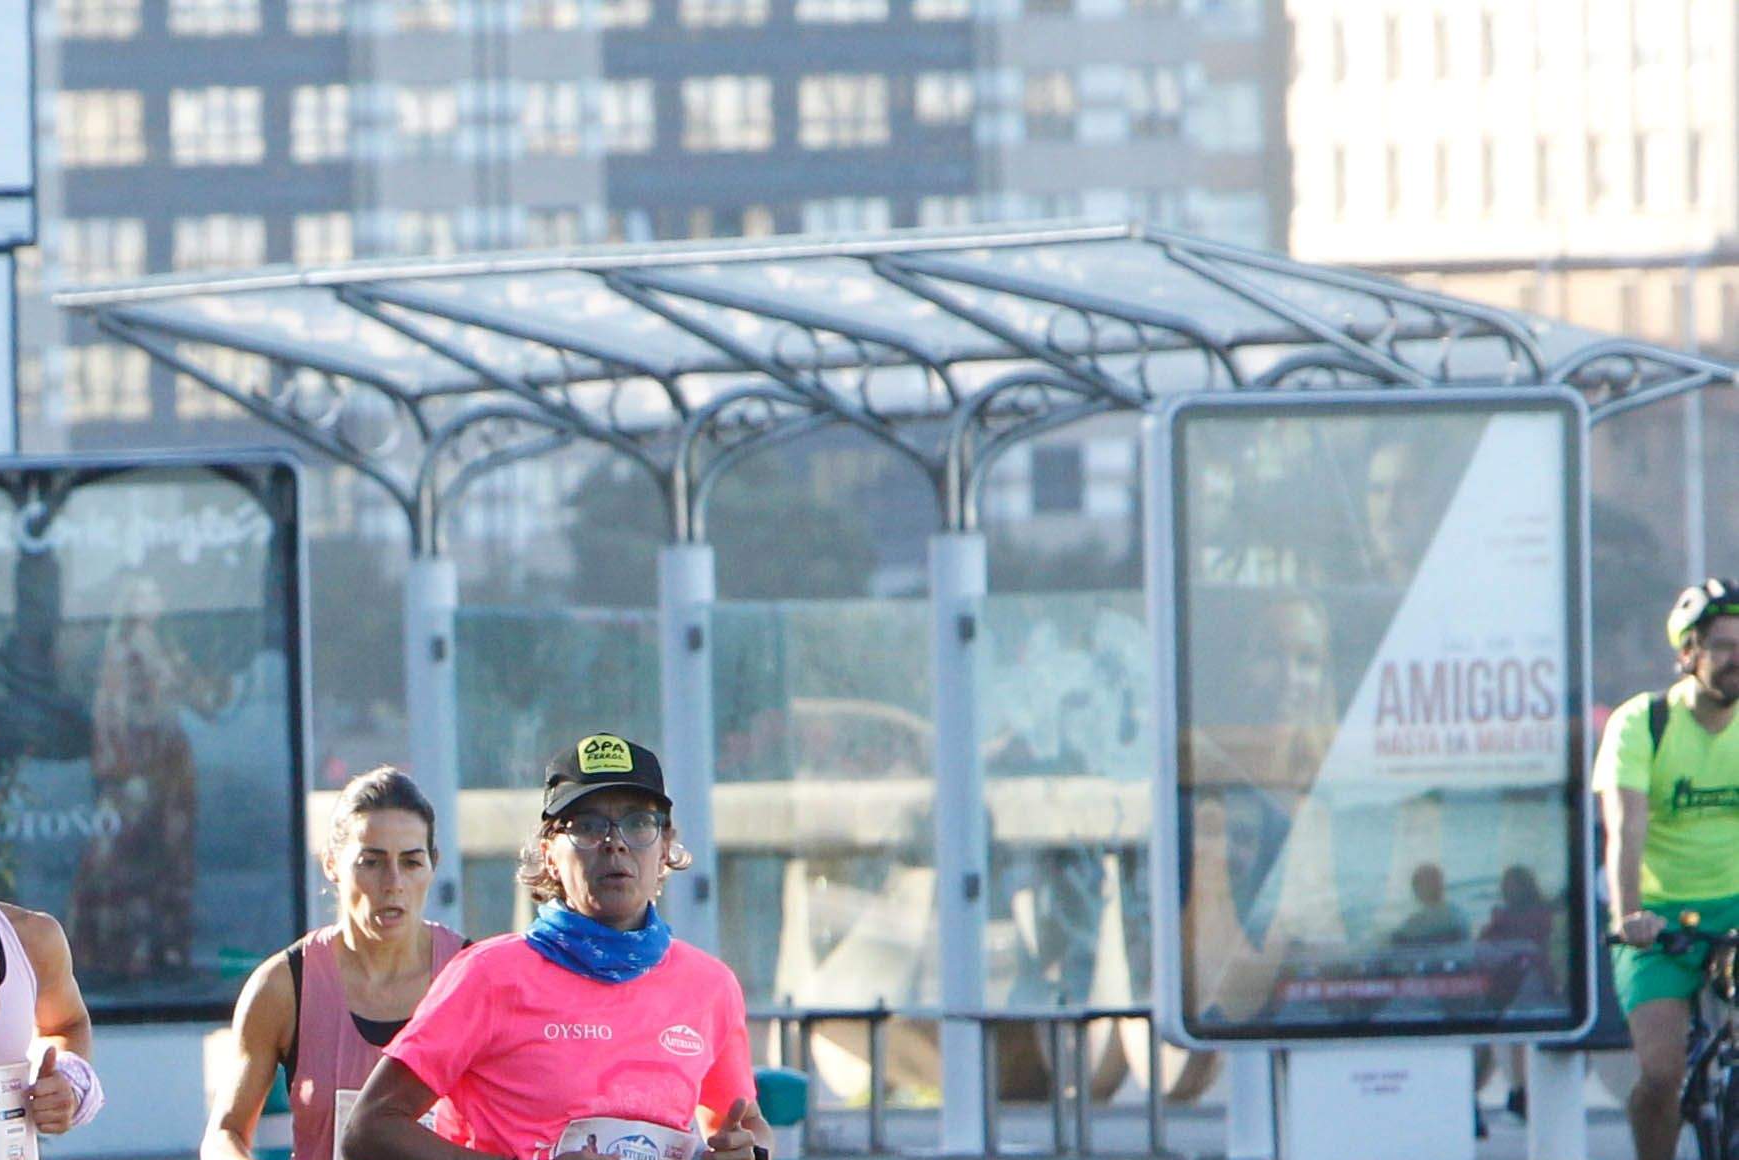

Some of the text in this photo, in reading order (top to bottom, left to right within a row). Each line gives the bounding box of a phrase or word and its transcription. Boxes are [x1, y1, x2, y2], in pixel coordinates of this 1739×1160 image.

[1375, 656, 1557, 726] AMIGOS
[584, 739, 625, 754] OPA
[543, 1023, 613, 1040] OYSHO
